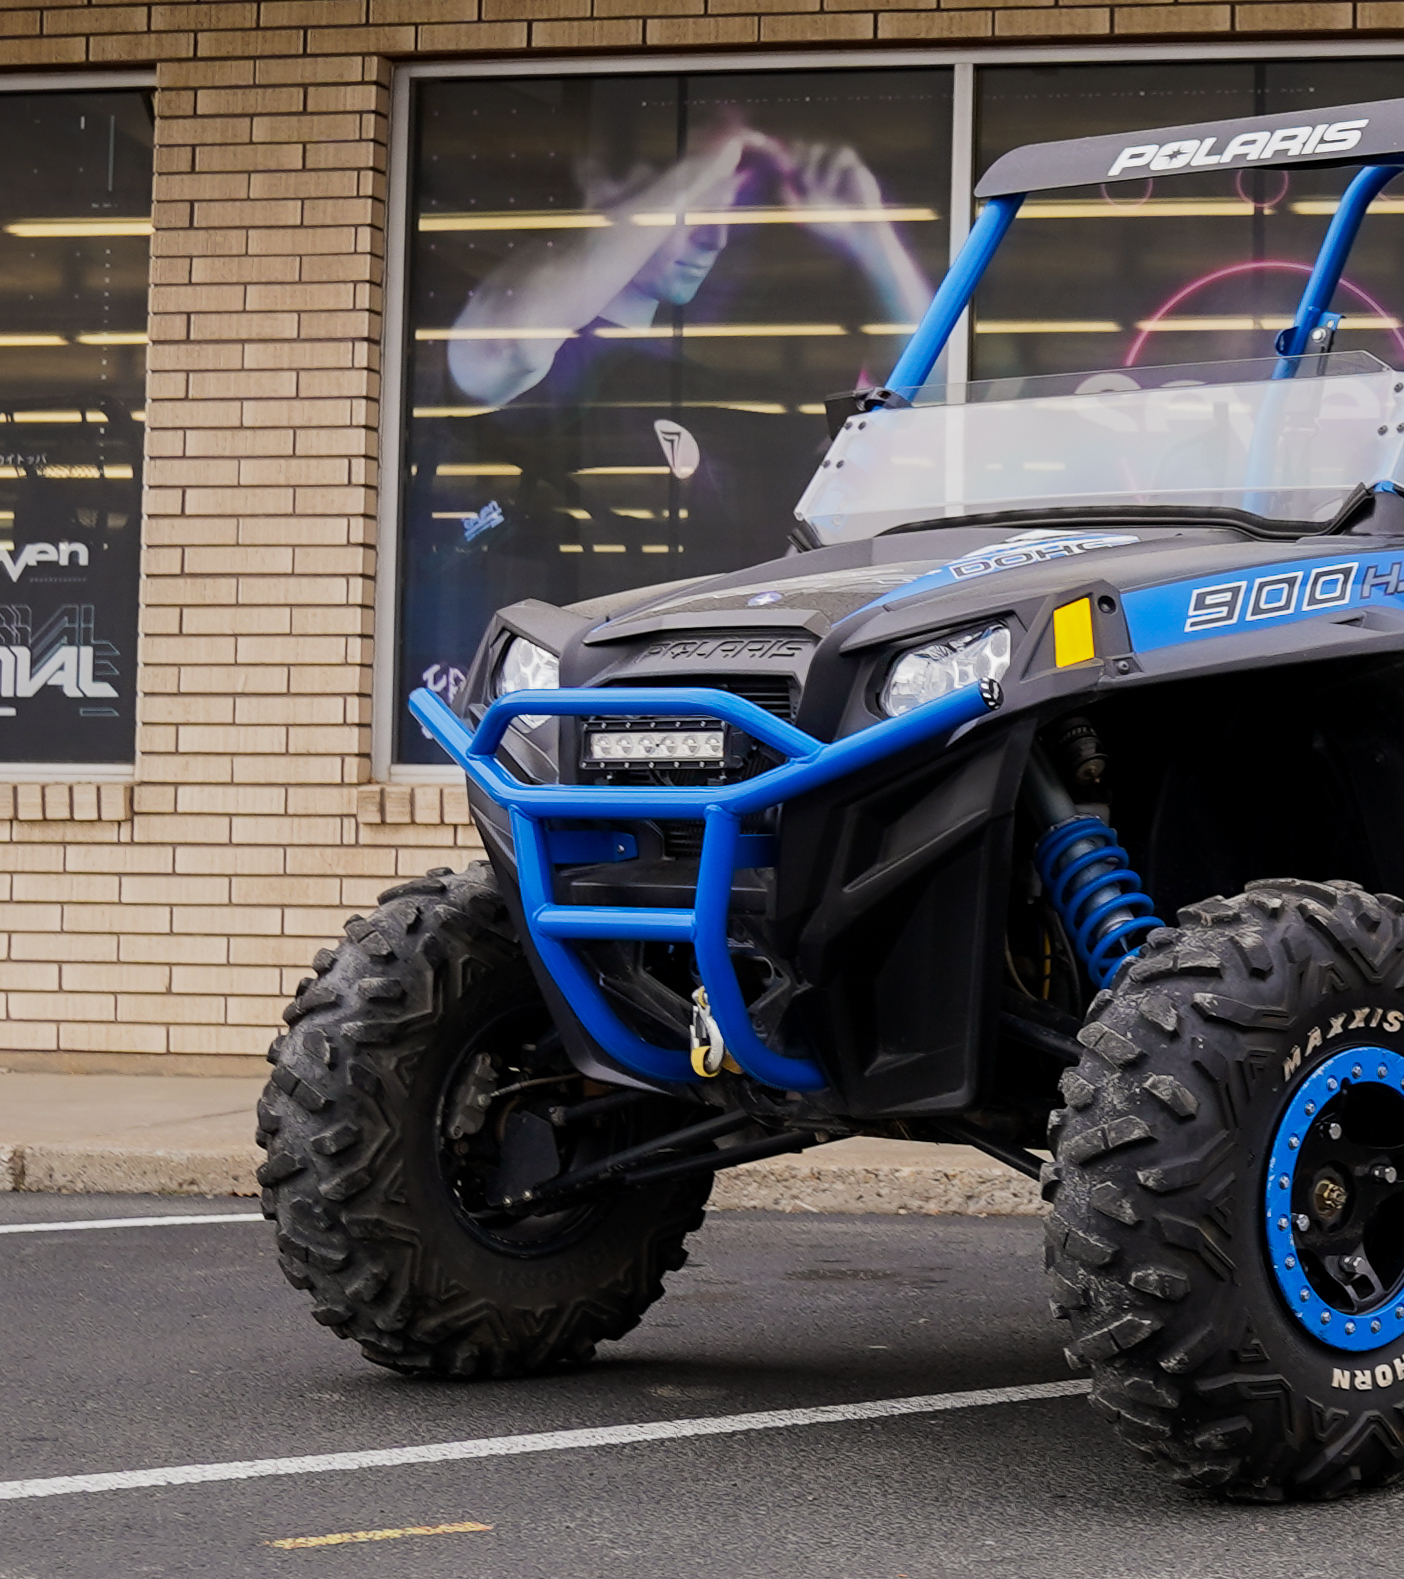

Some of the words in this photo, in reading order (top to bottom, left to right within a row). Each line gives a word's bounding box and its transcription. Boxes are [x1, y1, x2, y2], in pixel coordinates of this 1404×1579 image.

[1107, 118, 1370, 177] POLARIS
[1184, 561, 1360, 633] 900
[632, 639, 813, 664] POLARIS
